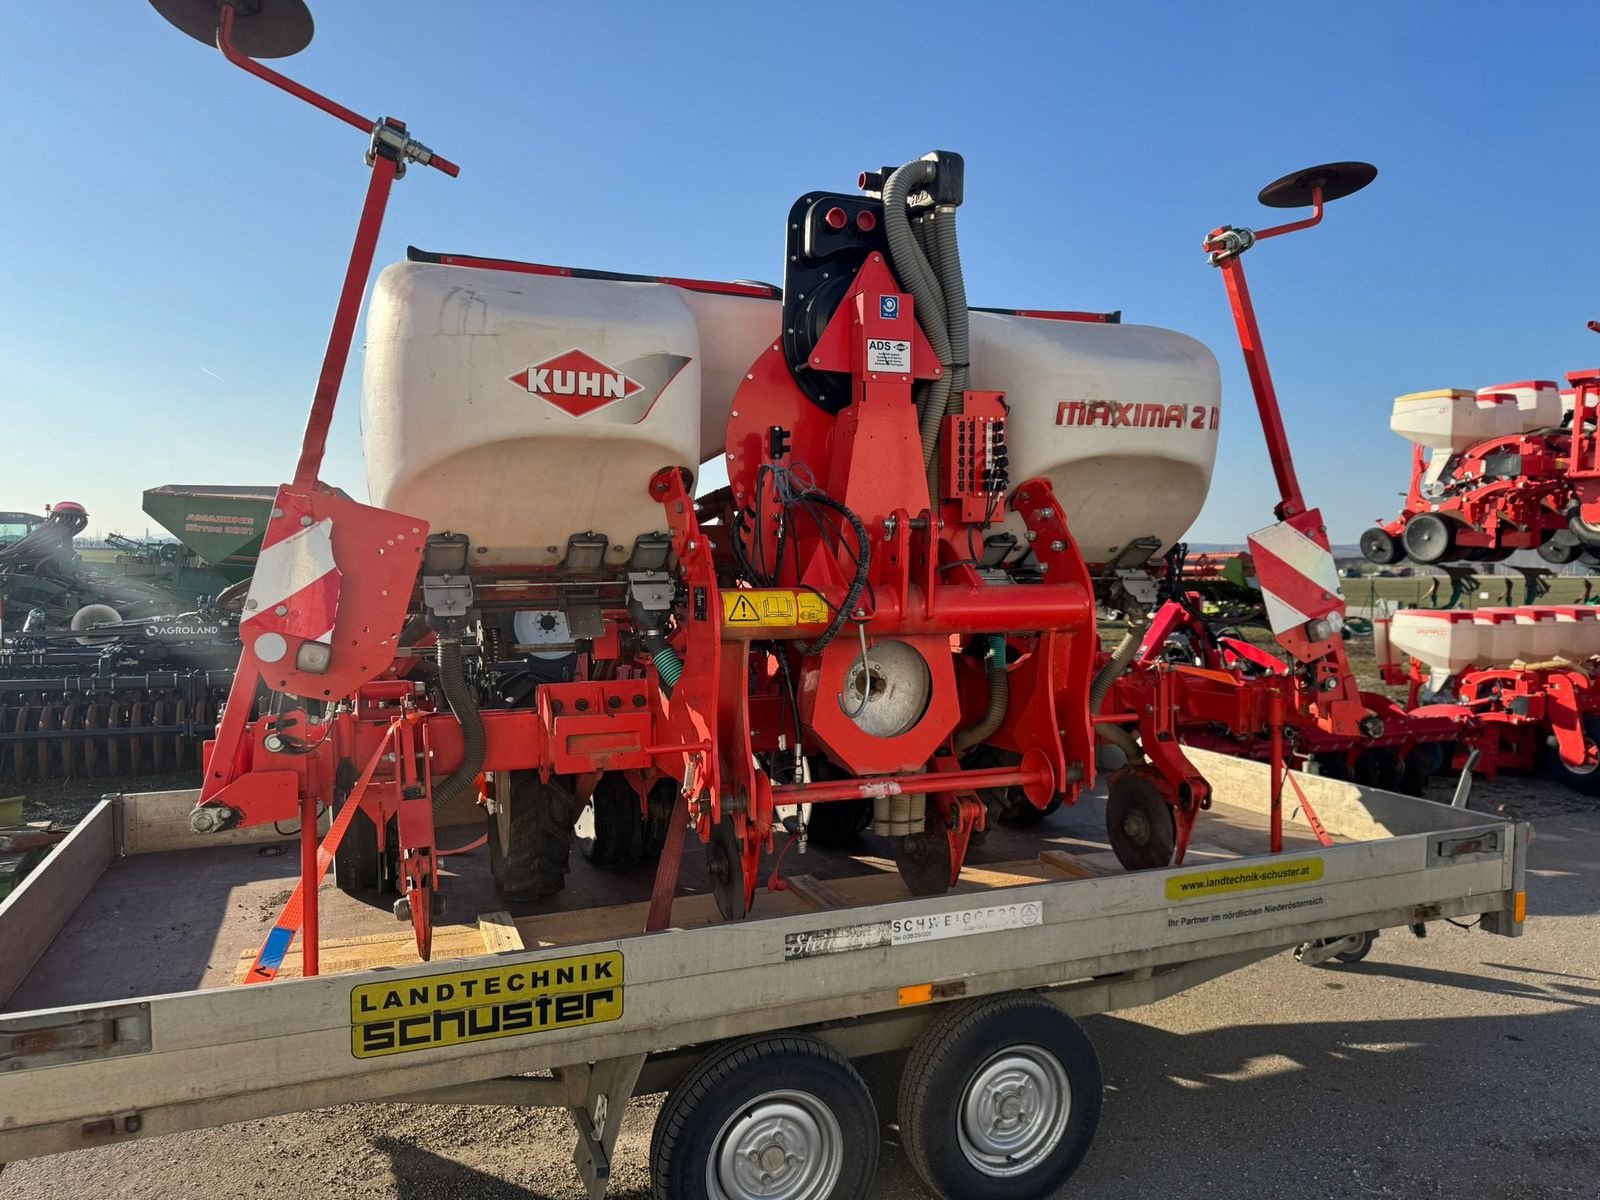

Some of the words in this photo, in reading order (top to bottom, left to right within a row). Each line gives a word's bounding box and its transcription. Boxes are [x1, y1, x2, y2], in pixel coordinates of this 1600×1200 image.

[869, 341, 891, 351] ADS
[527, 367, 626, 399] KUHN
[1055, 401, 1182, 428] MAXIMA
[1191, 406, 1206, 430] 2
[159, 626, 218, 635] AGROLAND
[1181, 866, 1310, 891] www.landtechnik-schuster.at
[1168, 919, 1179, 928] Ihr
[1180, 915, 1209, 926] Partner
[1211, 914, 1221, 922] im
[1222, 908, 1263, 921] nördlichen
[1264, 897, 1324, 914] Niederösterreich
[361, 961, 613, 1012] LANDTECHNIK
